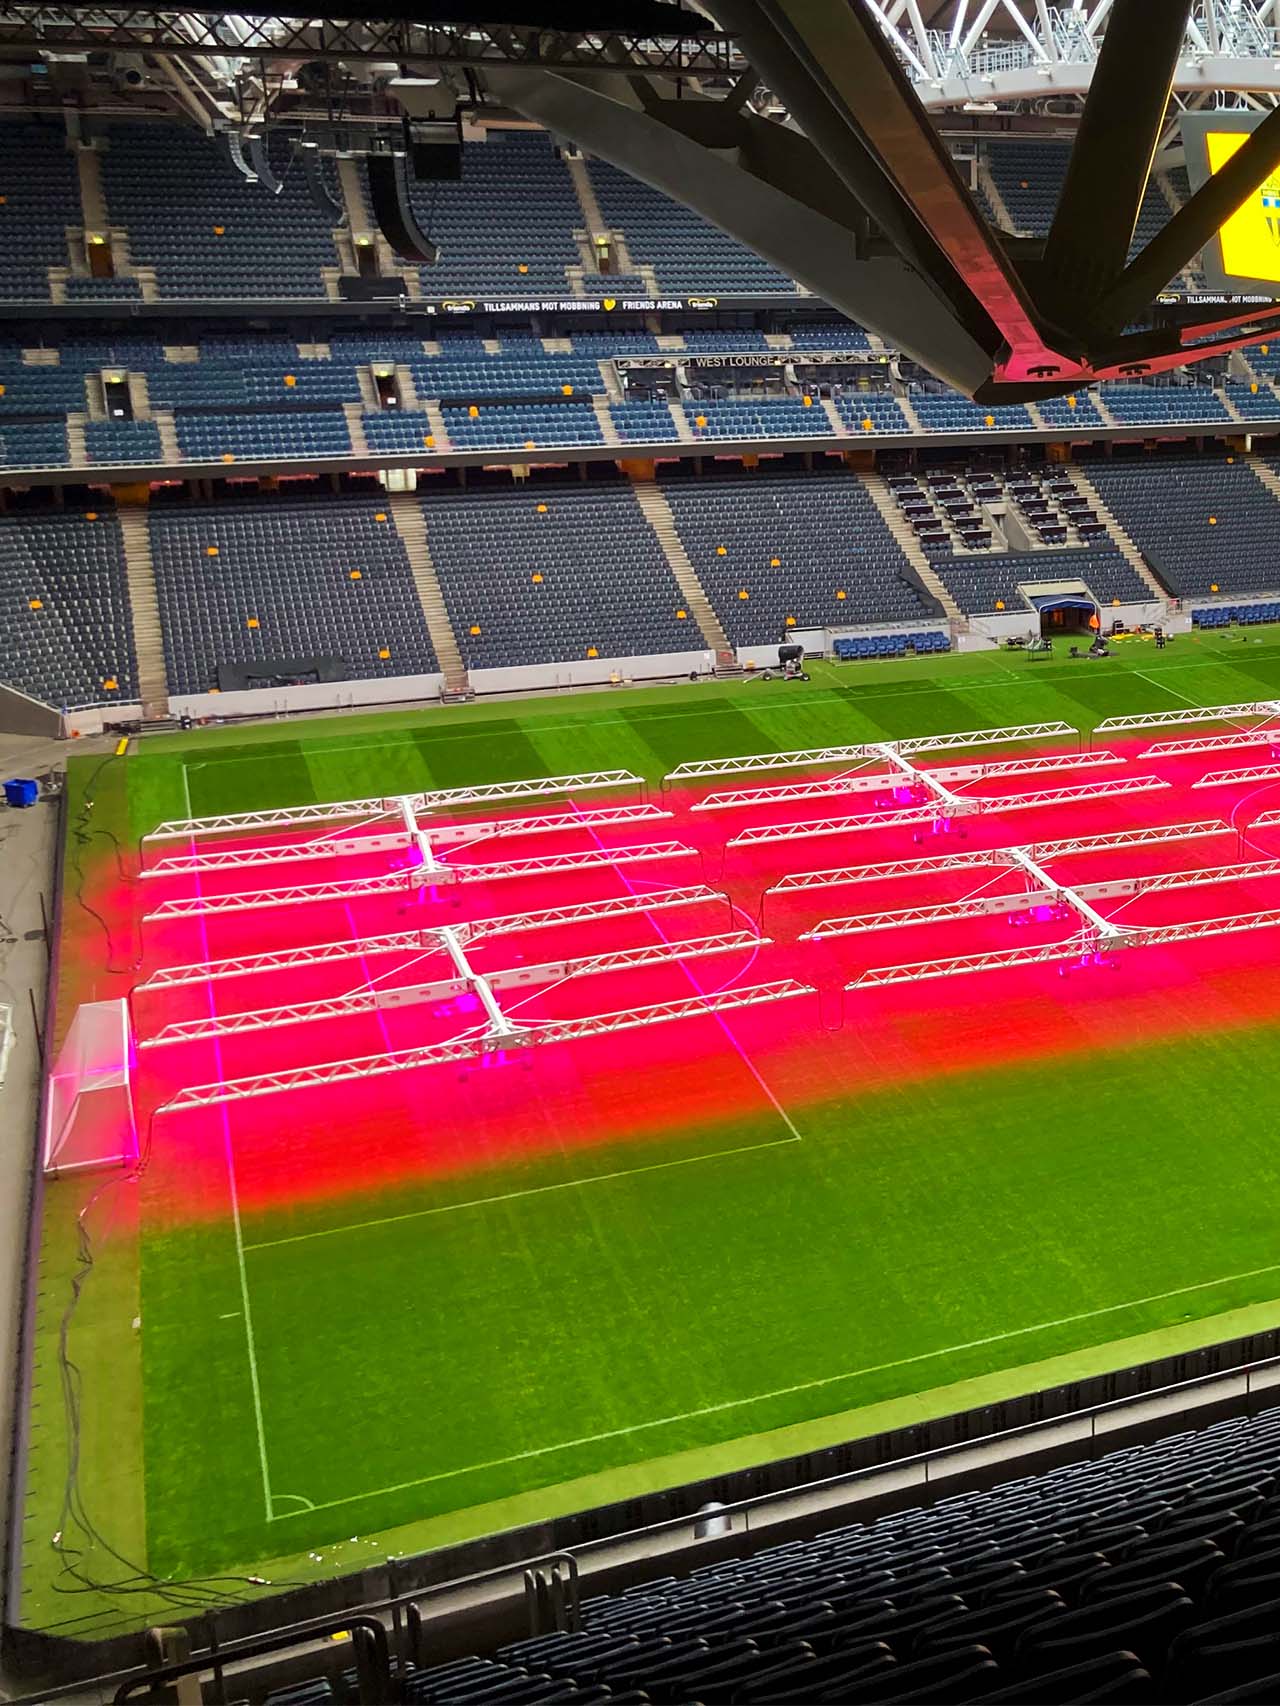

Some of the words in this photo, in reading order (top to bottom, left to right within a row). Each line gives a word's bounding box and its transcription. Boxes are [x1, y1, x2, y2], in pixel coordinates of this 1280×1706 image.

[483, 302, 540, 313] TILLSAMMANS
[541, 302, 558, 311] MOT
[559, 301, 601, 311] MOBBNING
[622, 300, 656, 310] FRIENDS
[656, 300, 683, 310] ARENA
[695, 357, 729, 367] WEST
[729, 356, 776, 367] LOUNGE
